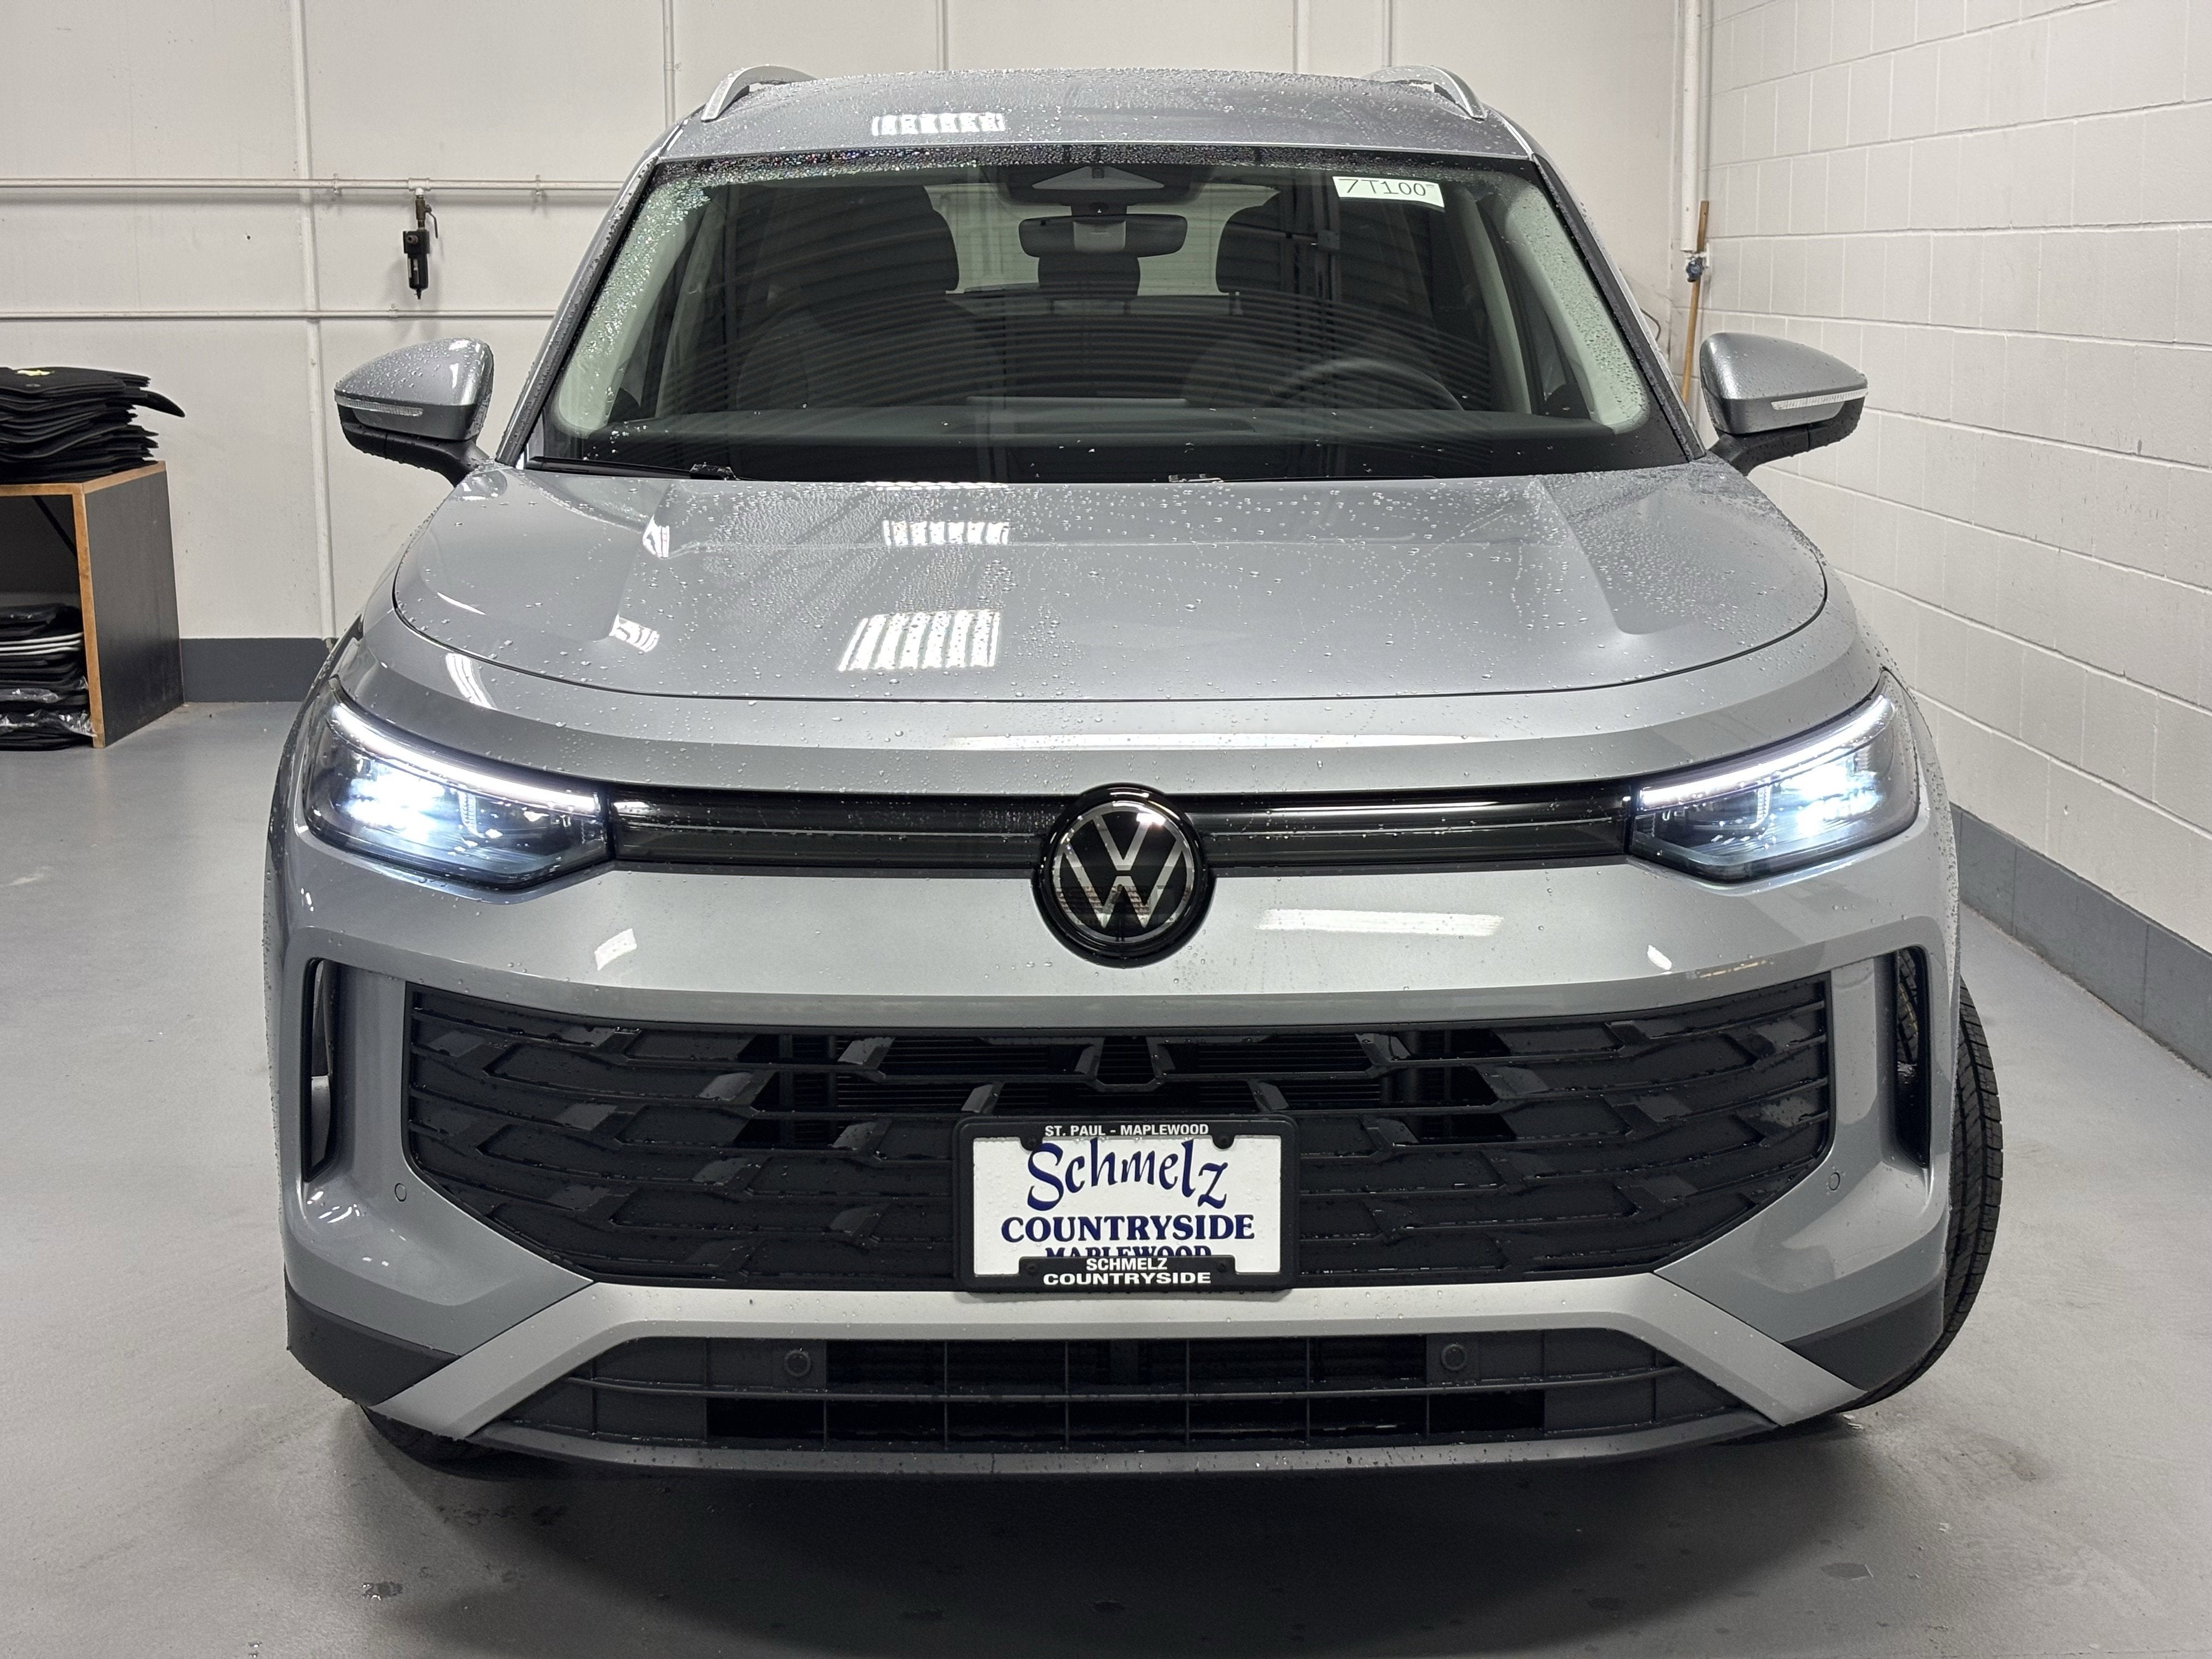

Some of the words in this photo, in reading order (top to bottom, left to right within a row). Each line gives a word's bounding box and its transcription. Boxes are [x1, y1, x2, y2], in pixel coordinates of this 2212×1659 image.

[1338, 178, 1426, 196] 7T100
[1045, 1125, 1066, 1137] ST.
[1070, 1125, 1106, 1136] PAUL
[1120, 1124, 1209, 1136] MAPLEWOOD
[1027, 1138, 1228, 1211] Schmelz
[1001, 1215, 1255, 1243] COUNTRYSIDE
[1086, 1257, 1168, 1271] SCHMELZ
[1043, 1272, 1211, 1285] COUNTRYSIDE
